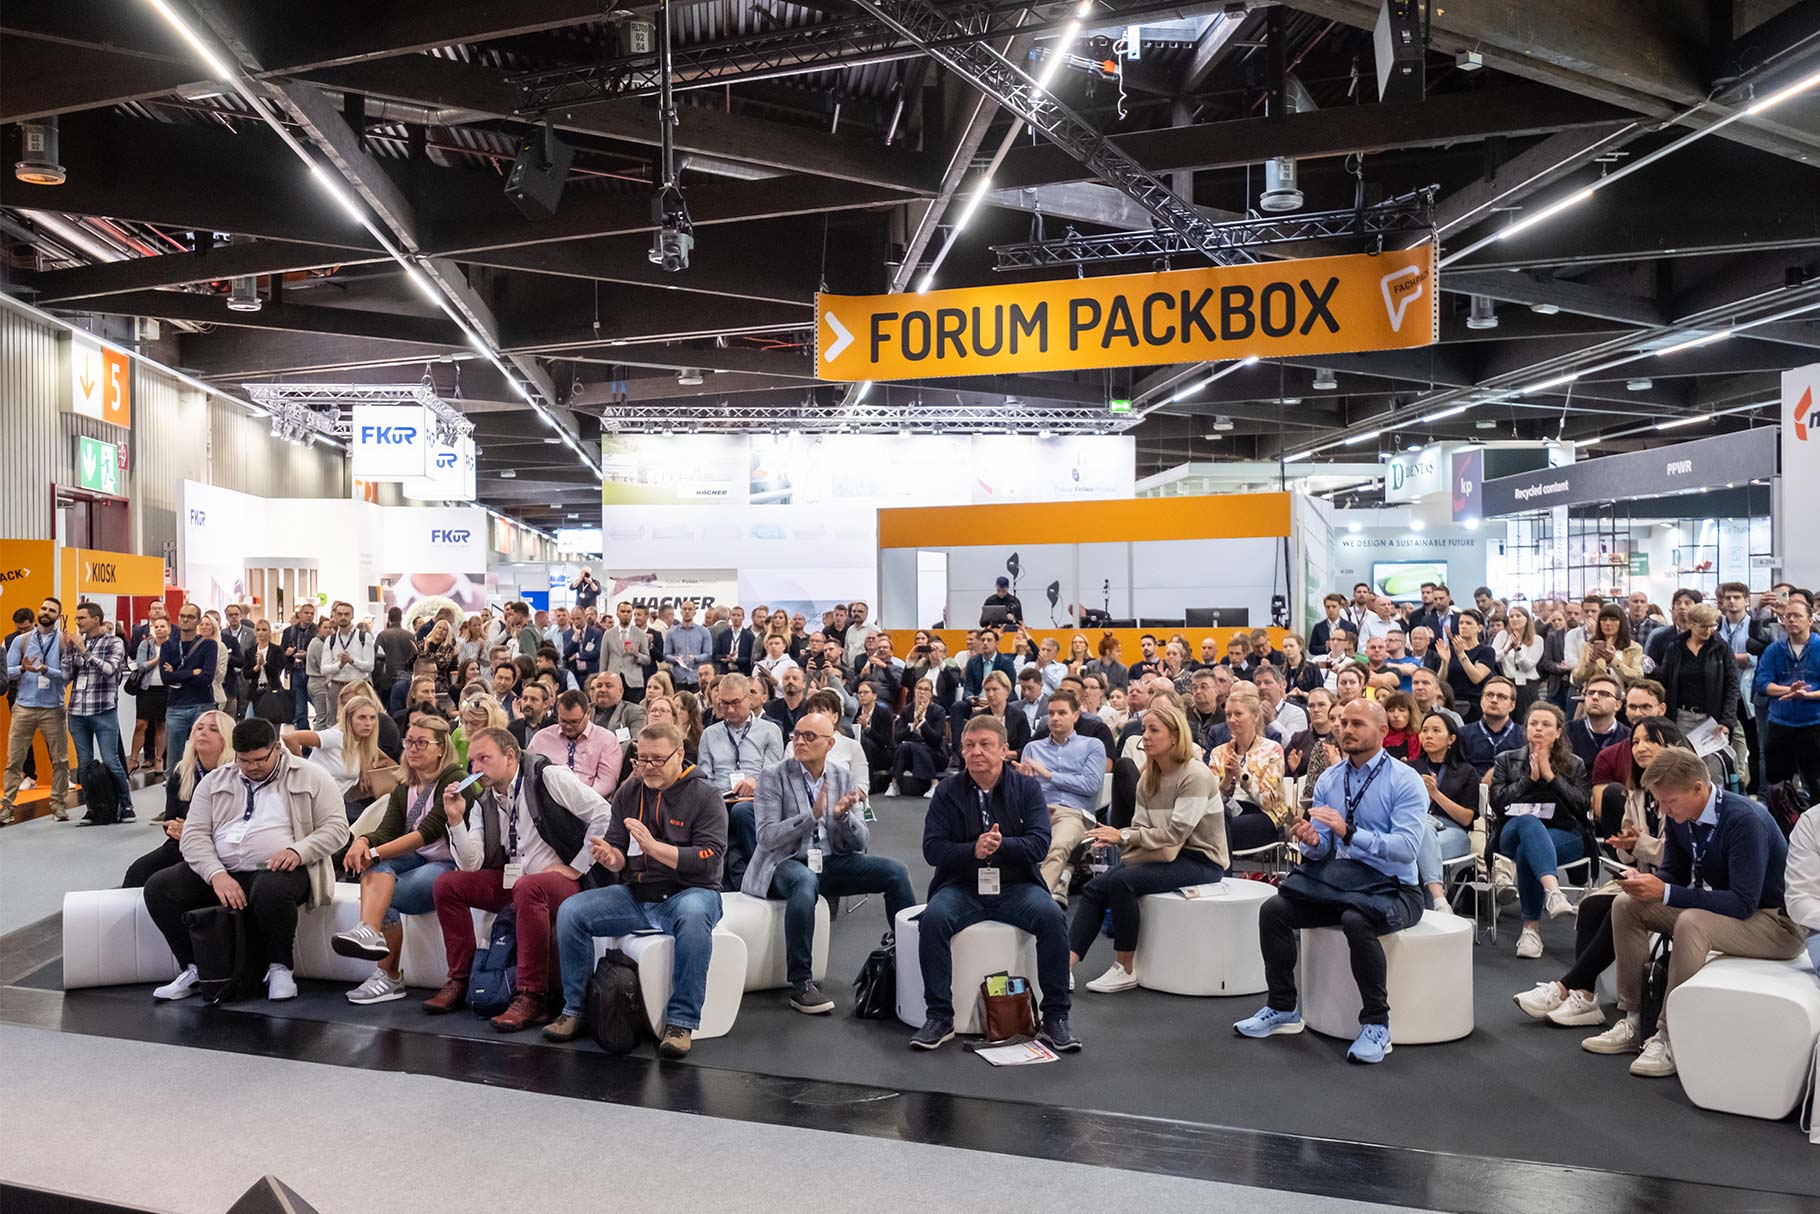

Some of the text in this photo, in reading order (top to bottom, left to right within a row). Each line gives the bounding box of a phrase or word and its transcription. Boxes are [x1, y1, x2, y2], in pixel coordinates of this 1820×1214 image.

[635, 33, 645, 41] 02
[636, 43, 646, 51] 04
[870, 277, 1340, 364] FORUM PACKBOX
[112, 362, 121, 412] 5
[1666, 460, 1692, 476] PPWR
[1460, 477, 1473, 497] kp
[1514, 480, 1570, 501] Recycled content
[1342, 538, 1475, 547] WE DESIGN A SUSTAINABLE FUTURE
[92, 562, 116, 583] KIOSK
